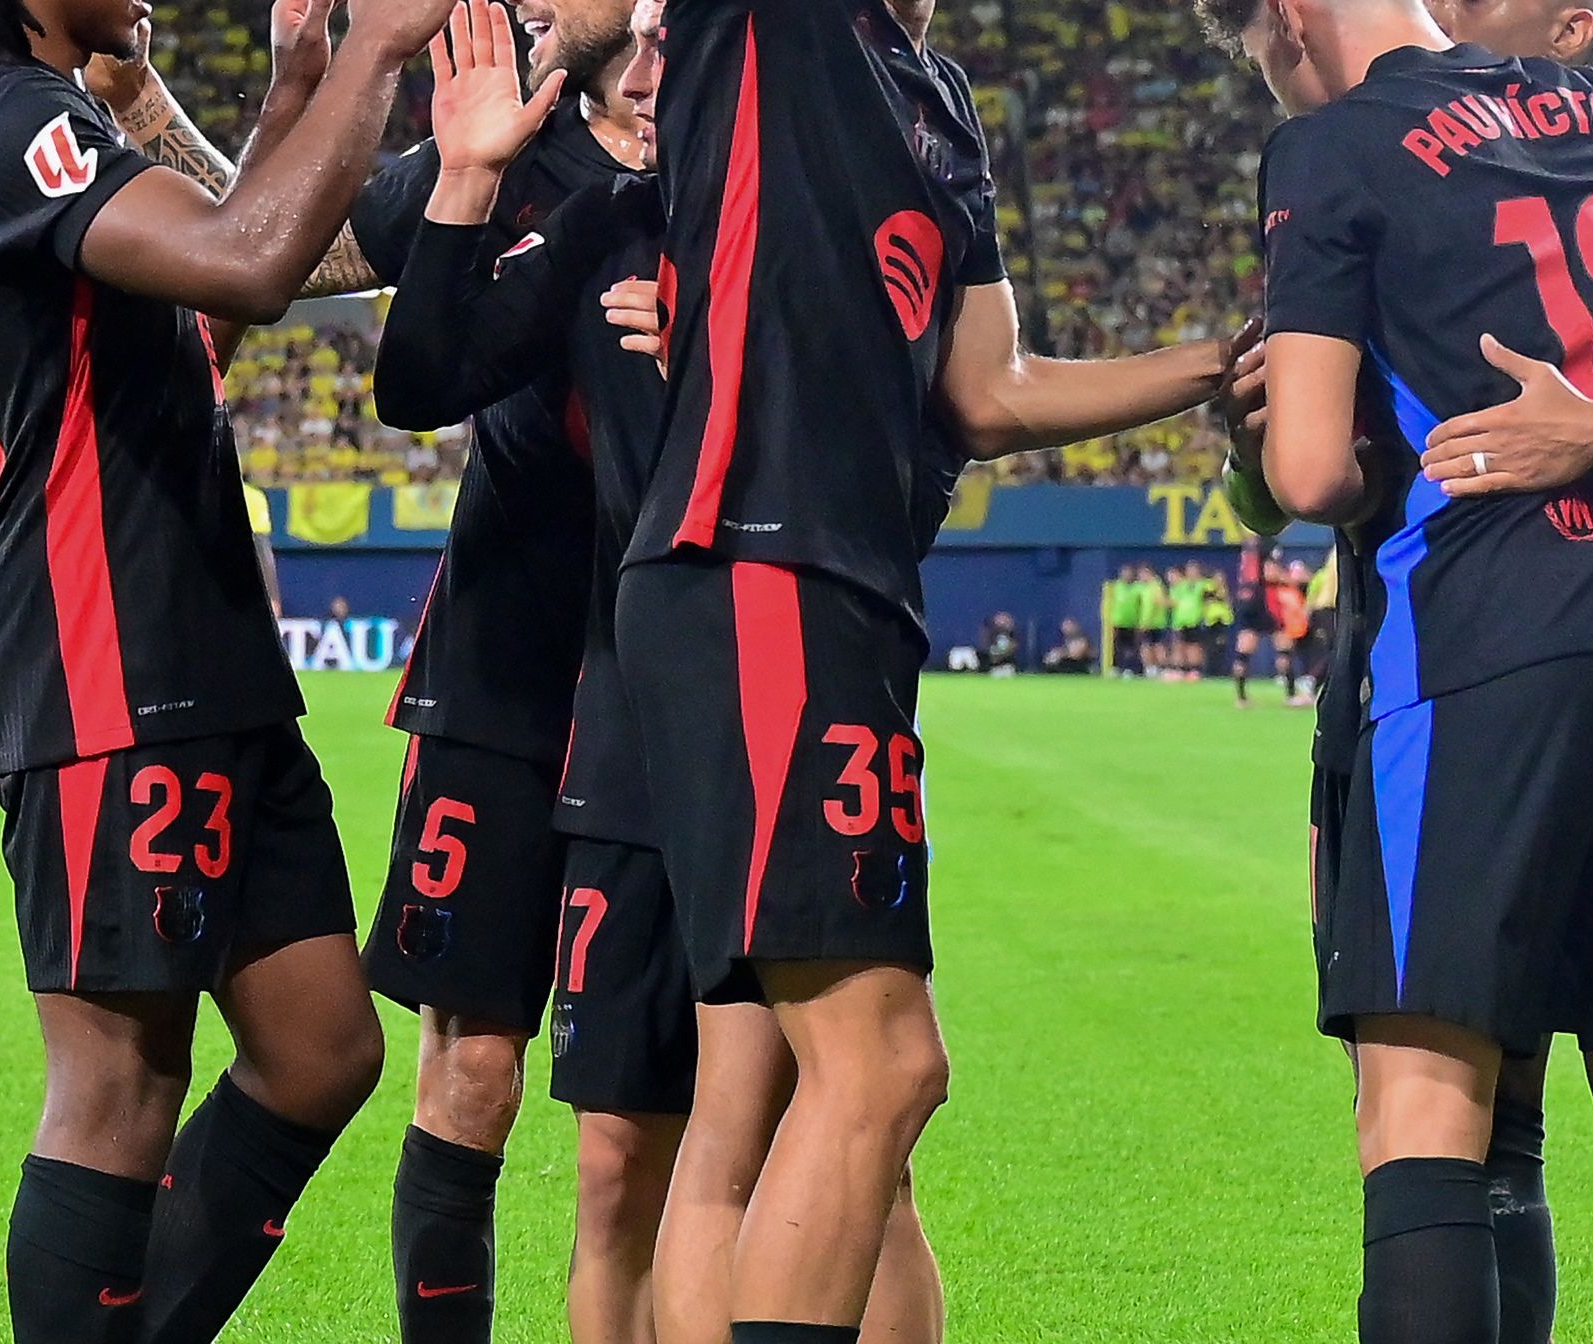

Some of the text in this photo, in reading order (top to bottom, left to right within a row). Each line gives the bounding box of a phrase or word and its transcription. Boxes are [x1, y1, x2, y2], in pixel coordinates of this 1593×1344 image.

[277, 617, 400, 673] TAU
[129, 763, 233, 879] 23
[820, 722, 923, 844] 35
[411, 796, 477, 899] 5
